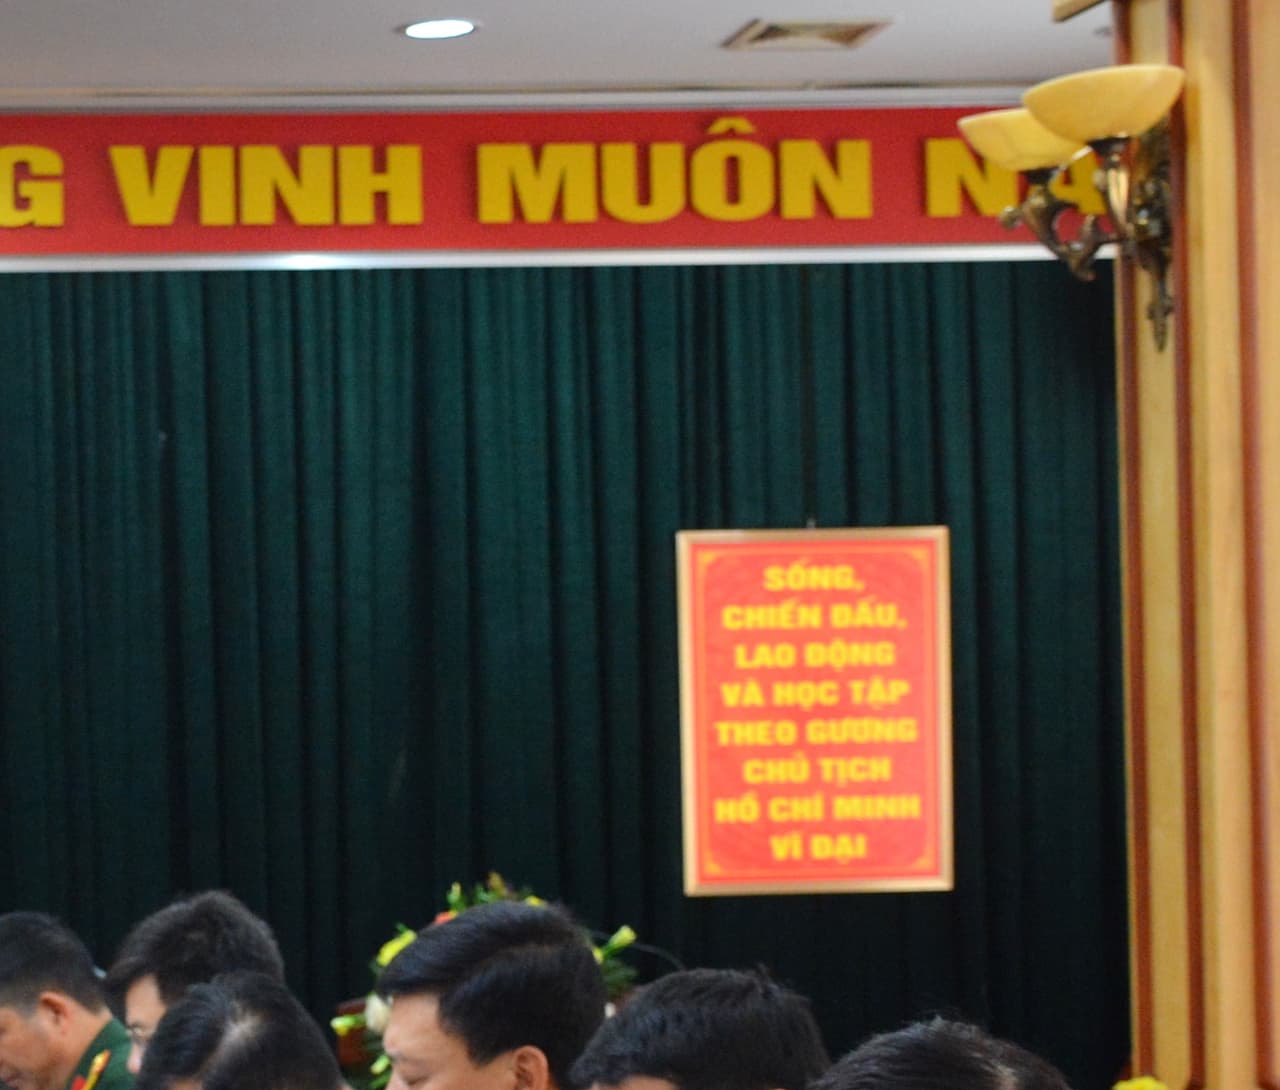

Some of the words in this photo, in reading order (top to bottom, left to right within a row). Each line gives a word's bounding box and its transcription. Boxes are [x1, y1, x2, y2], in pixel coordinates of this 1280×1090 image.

[108, 144, 424, 228] VINH
[475, 117, 874, 225] MUÔN
[736, 644, 795, 668] LAO
[774, 681, 839, 710] HỌC
[716, 721, 797, 745] THEO
[819, 757, 892, 786] TỊCH
[834, 796, 921, 820] MINH
